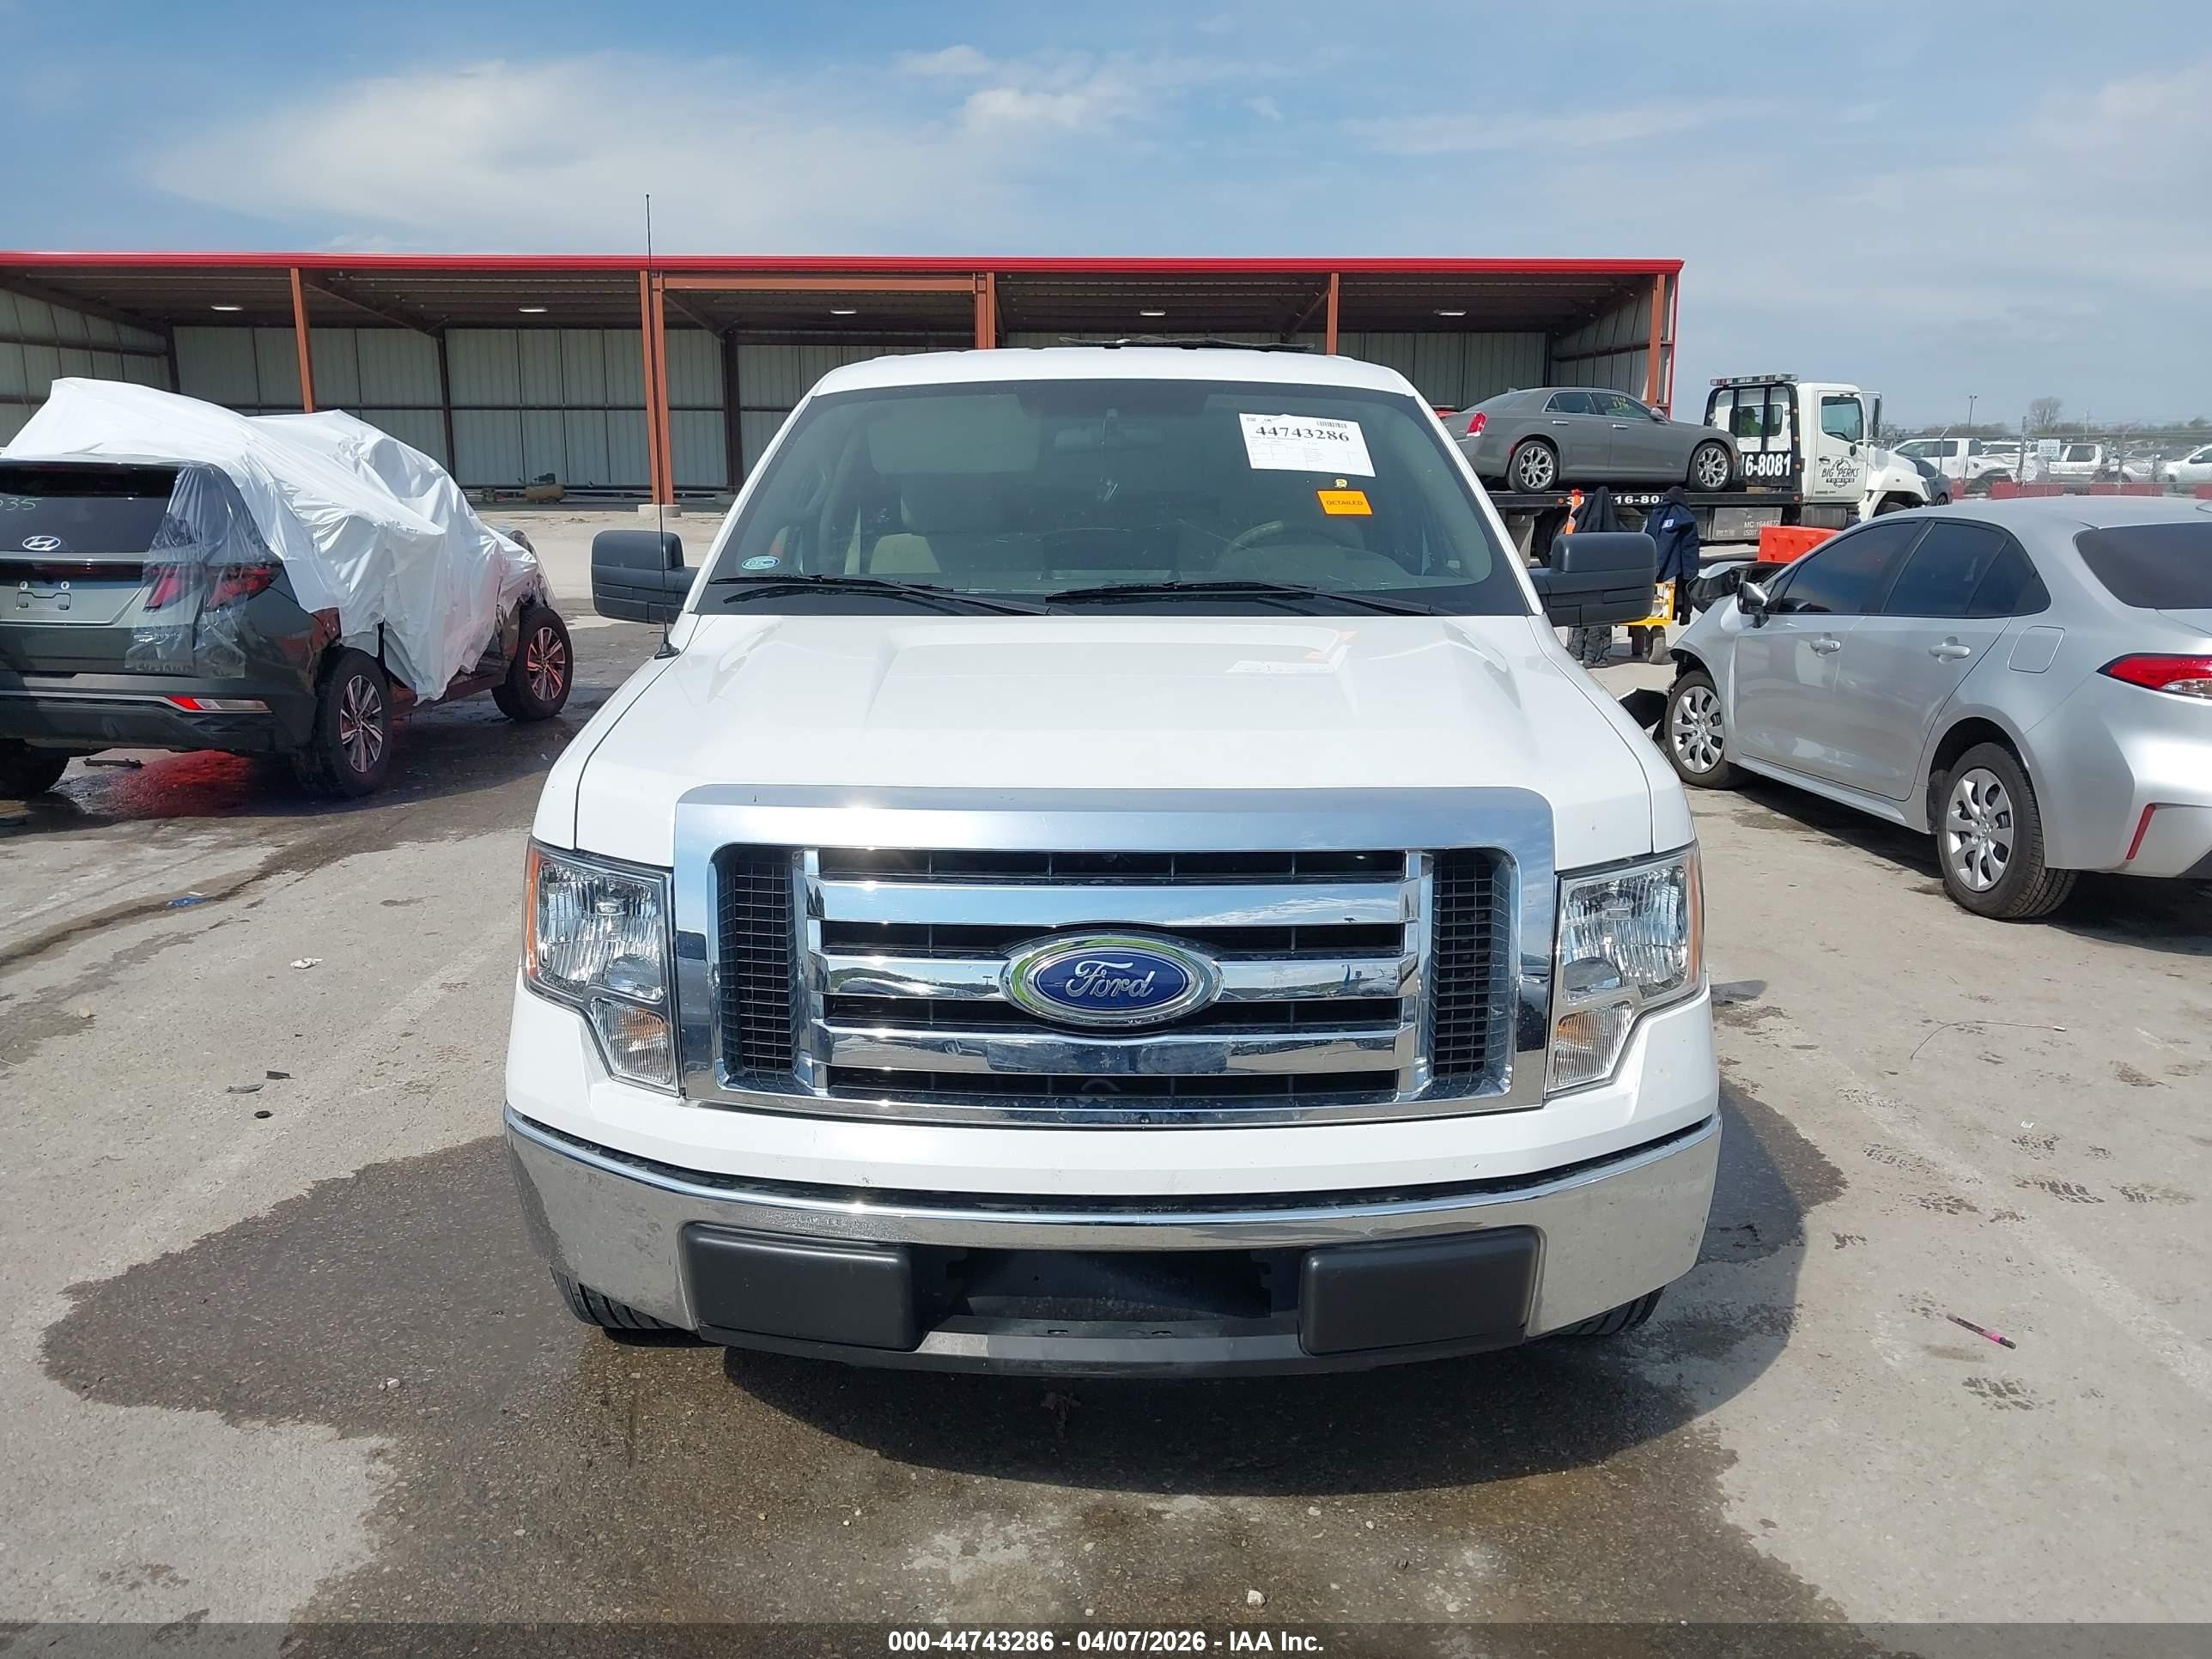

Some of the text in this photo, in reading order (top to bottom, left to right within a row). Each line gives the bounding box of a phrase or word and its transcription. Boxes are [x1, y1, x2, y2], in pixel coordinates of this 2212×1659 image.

[1255, 426, 1350, 442] 44743286
[1821, 467, 1860, 477] BIG PERKS
[1610, 495, 1663, 505] 16-80
[1066, 960, 1156, 998] Ford
